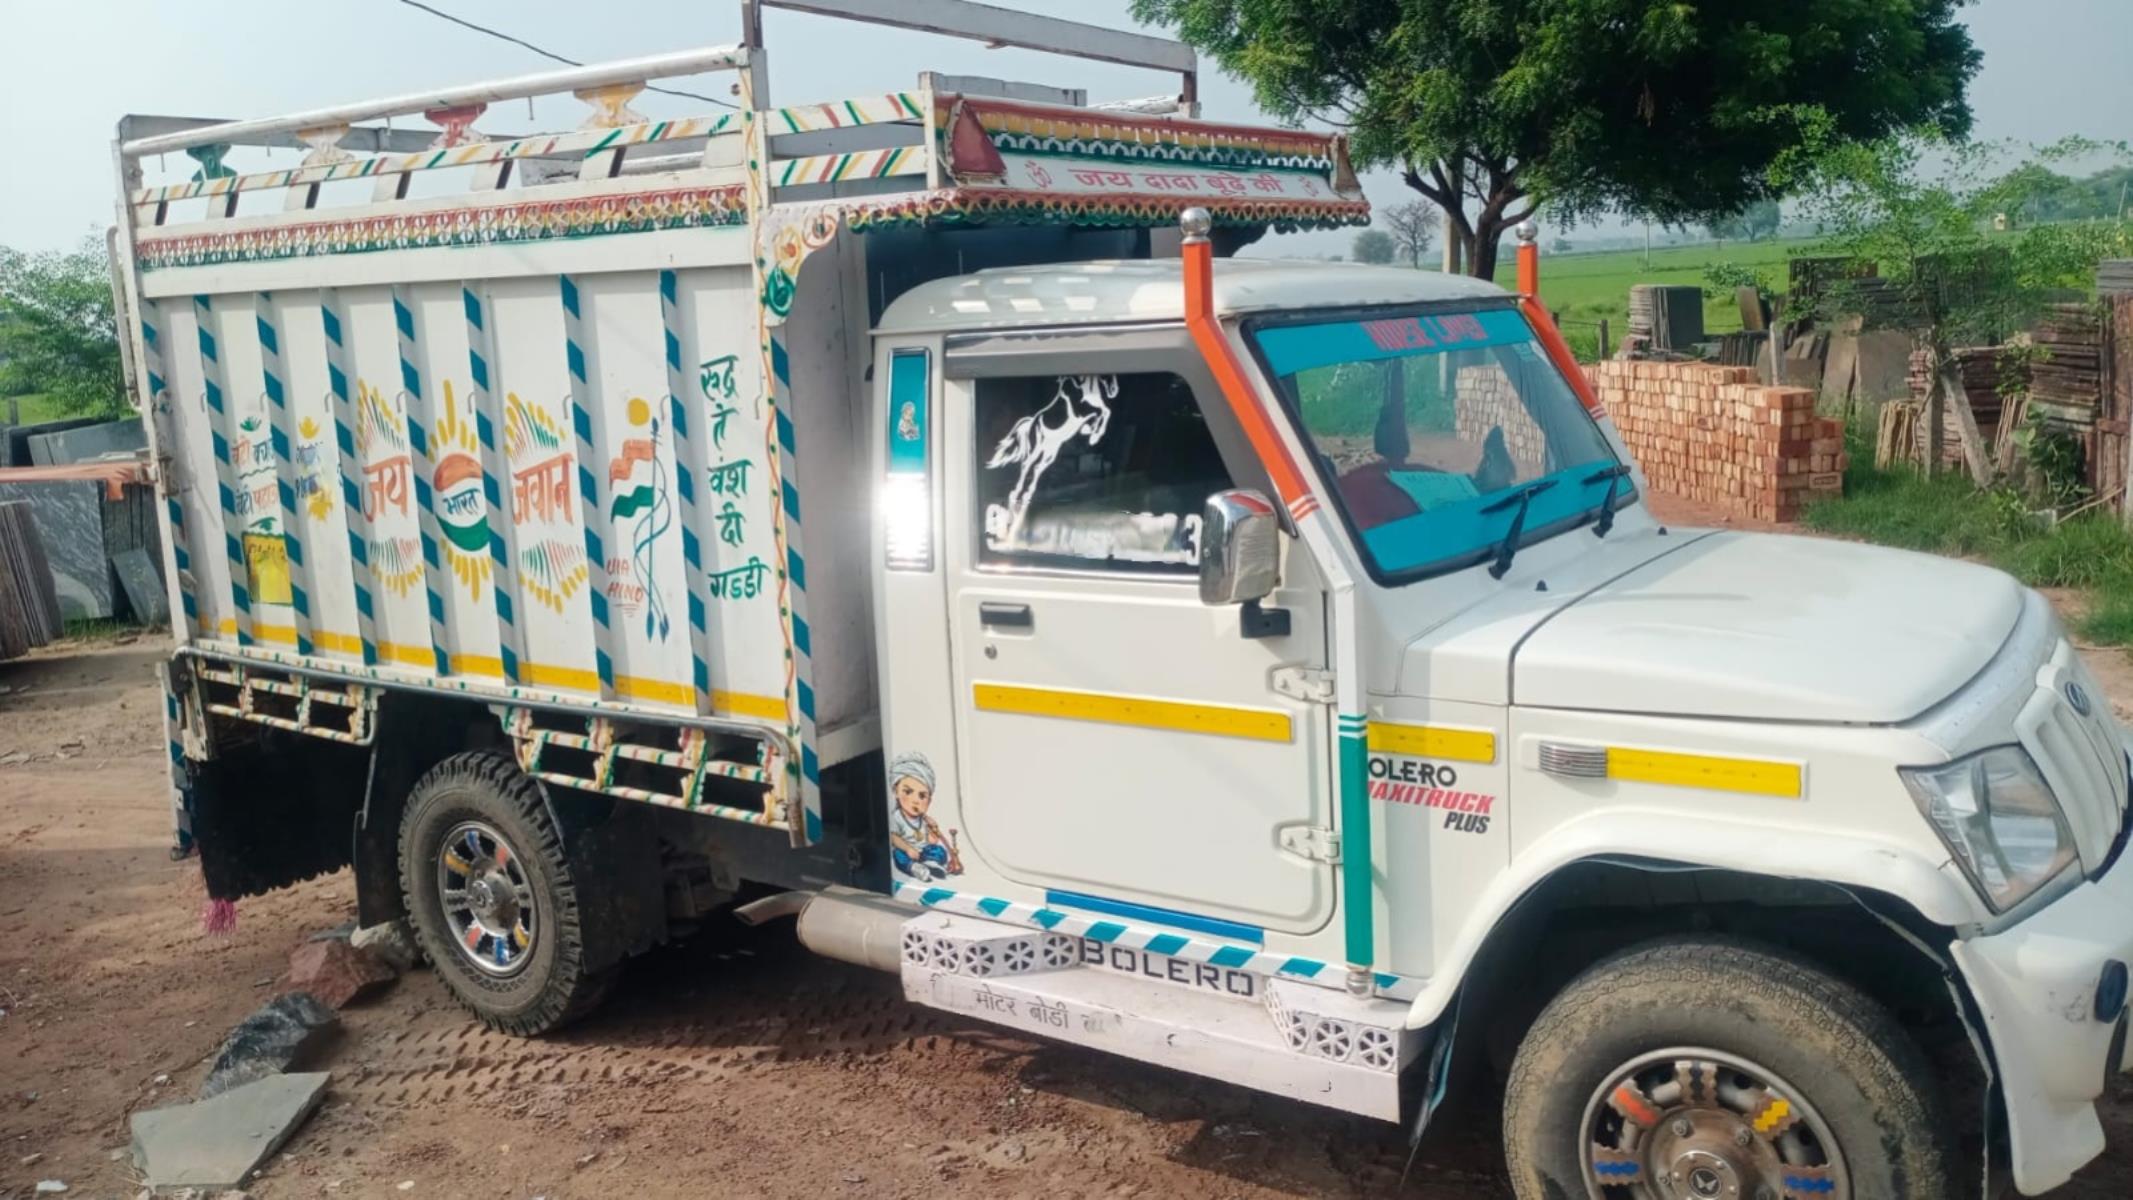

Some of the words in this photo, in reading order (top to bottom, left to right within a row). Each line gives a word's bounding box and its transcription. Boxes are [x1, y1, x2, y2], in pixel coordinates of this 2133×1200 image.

[1067, 168, 1133, 189] जय
[1140, 172, 1199, 191] दादा
[1247, 172, 1284, 193] की
[361, 455, 411, 523] जय
[443, 488, 481, 516] भारत
[512, 452, 574, 526] जवान
[715, 502, 746, 548] दी
[1368, 757, 1457, 788] OLERO
[1368, 780, 1496, 815] AXITRUCK
[1443, 811, 1491, 834] PLUS
[1080, 937, 1253, 997] BOLERO
[973, 983, 1018, 1017] मोटर
[1026, 995, 1069, 1030] बोडी
